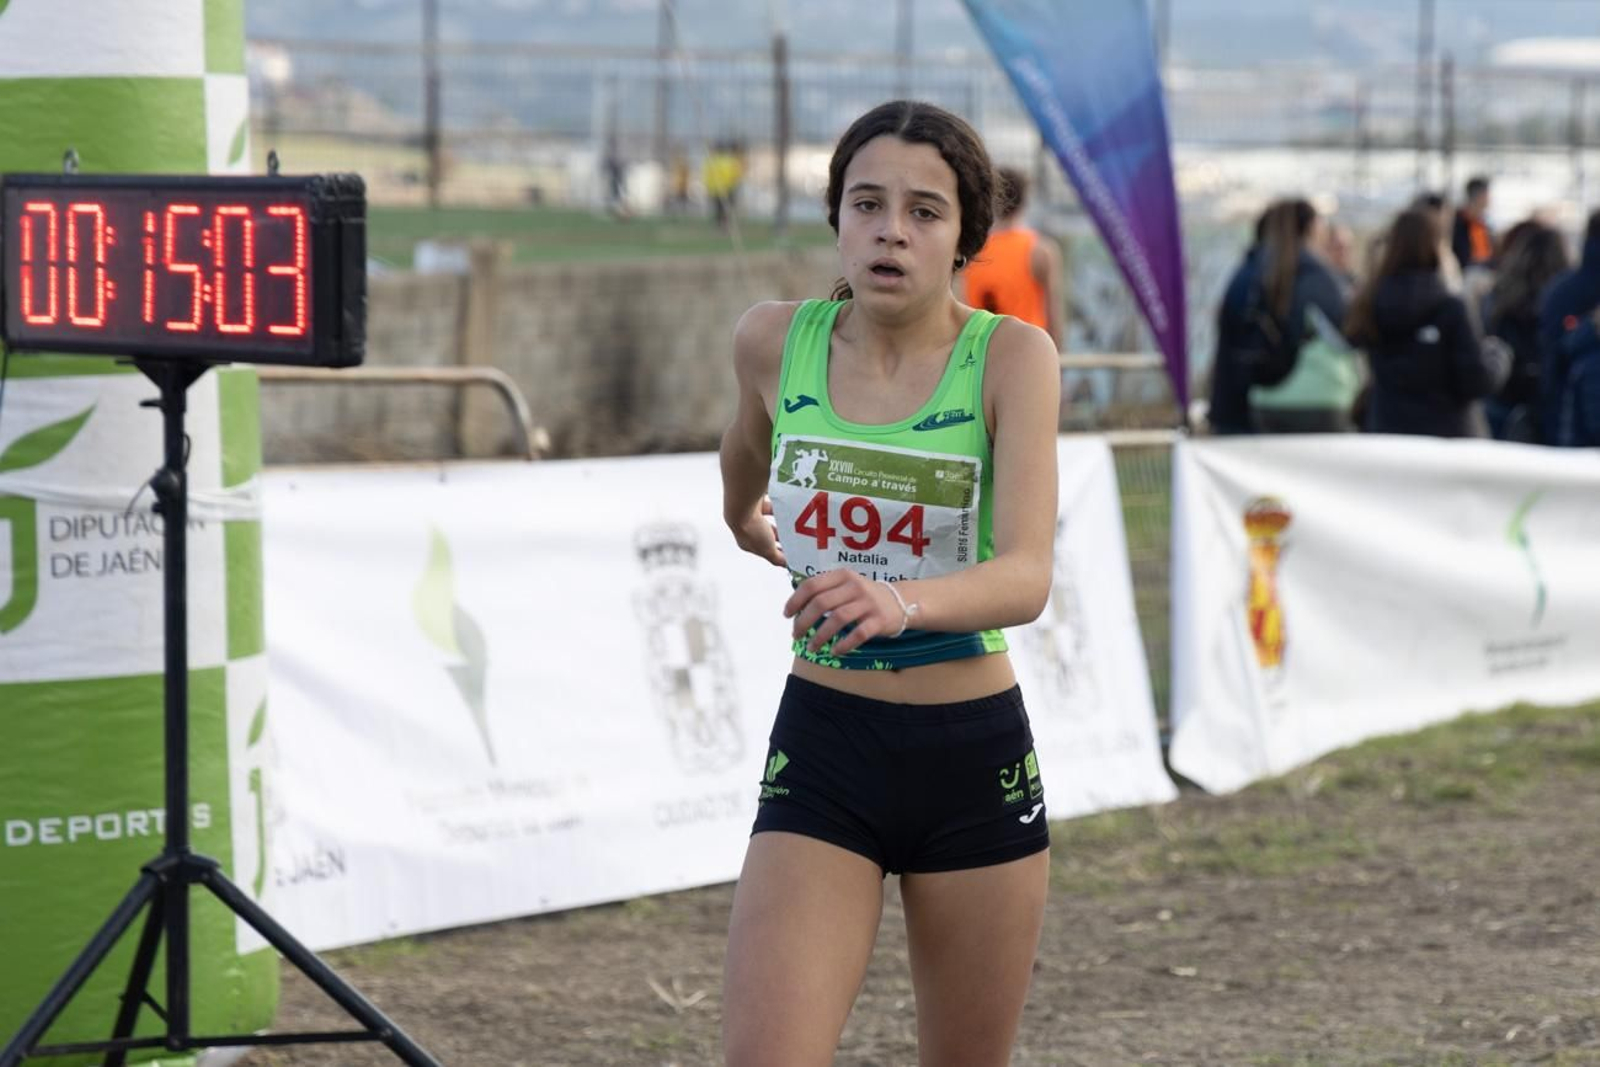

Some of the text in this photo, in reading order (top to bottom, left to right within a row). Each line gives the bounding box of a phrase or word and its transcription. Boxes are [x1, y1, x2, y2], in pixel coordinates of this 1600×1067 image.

[20, 203, 308, 335] 00:15:03
[827, 471, 917, 493] Campo a través
[50, 511, 206, 542] DIPUTAC
[794, 491, 931, 557] 494
[51, 545, 163, 579] DE JAÉN
[837, 551, 889, 566] Natalia
[5, 804, 211, 846] DEPORTS
